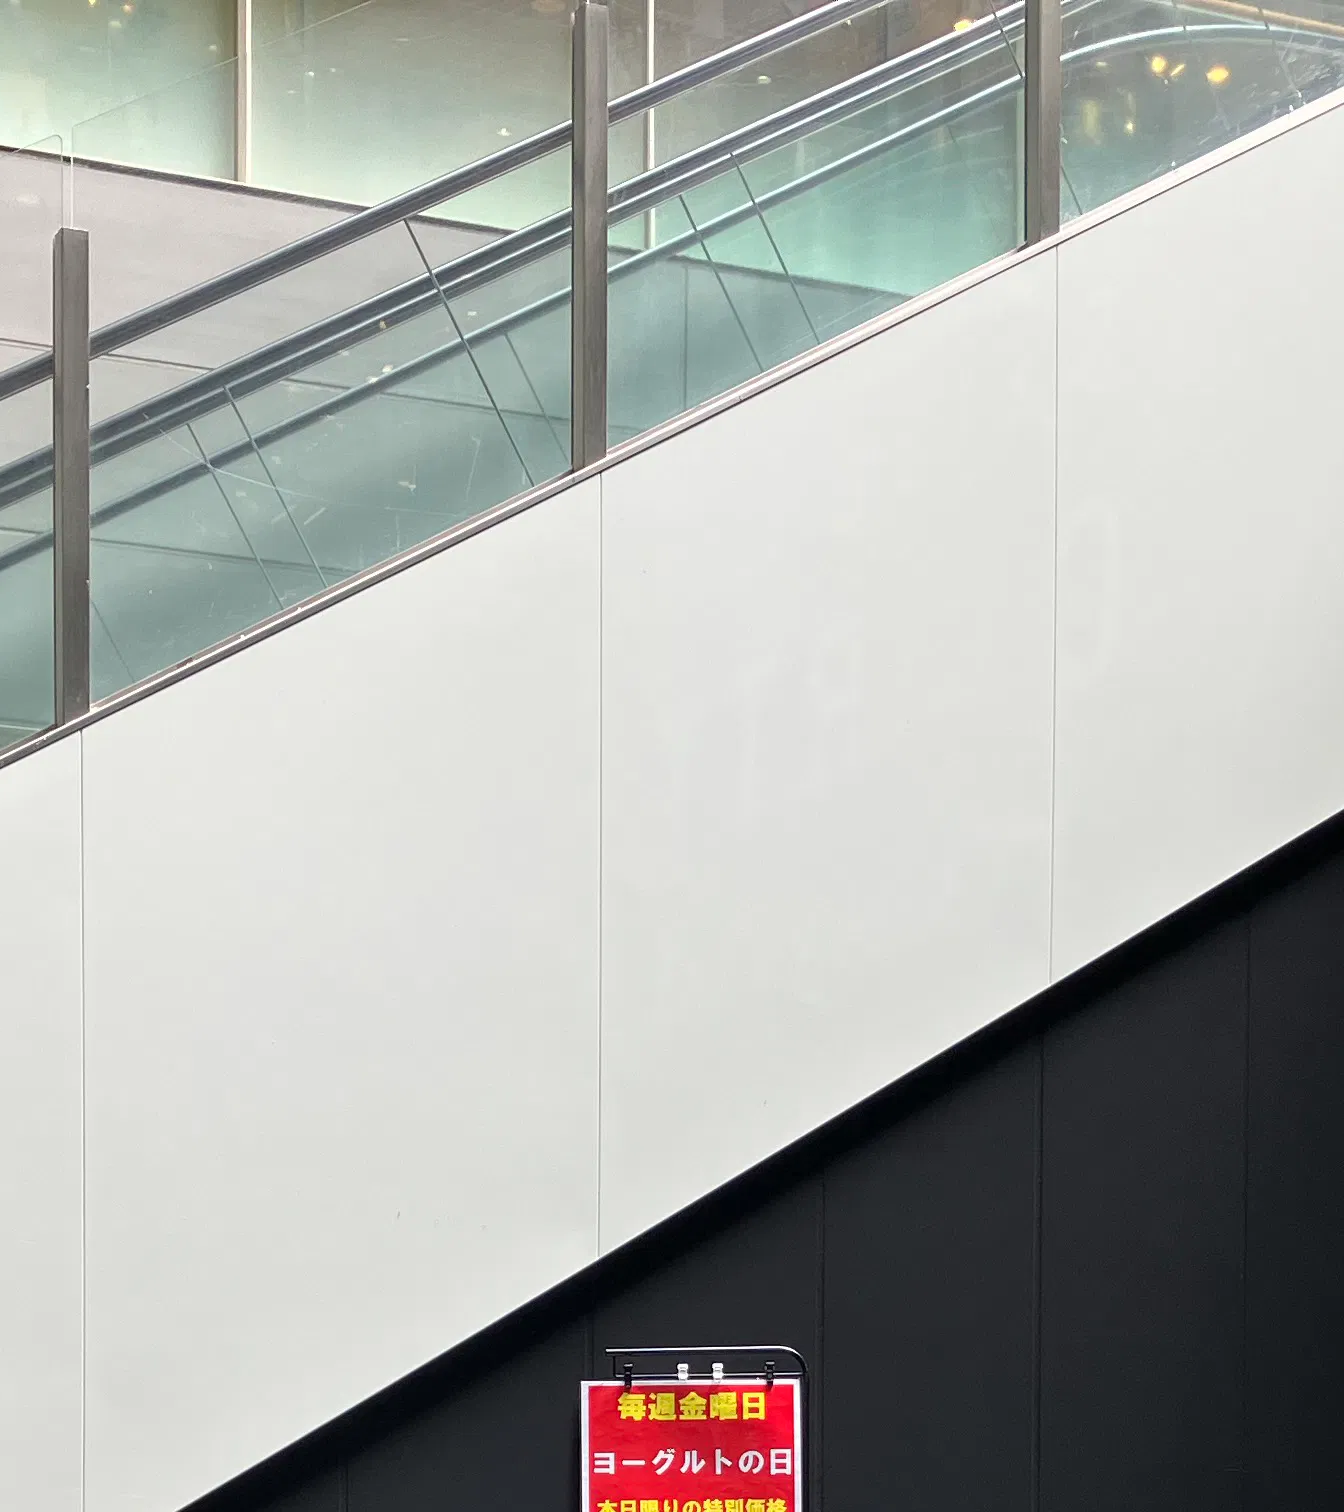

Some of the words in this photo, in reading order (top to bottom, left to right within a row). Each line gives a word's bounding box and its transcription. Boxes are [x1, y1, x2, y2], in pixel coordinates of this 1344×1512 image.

[617, 1391, 766, 1421] 毎週金曜日
[593, 1448, 792, 1475] ヨーグルトの日
